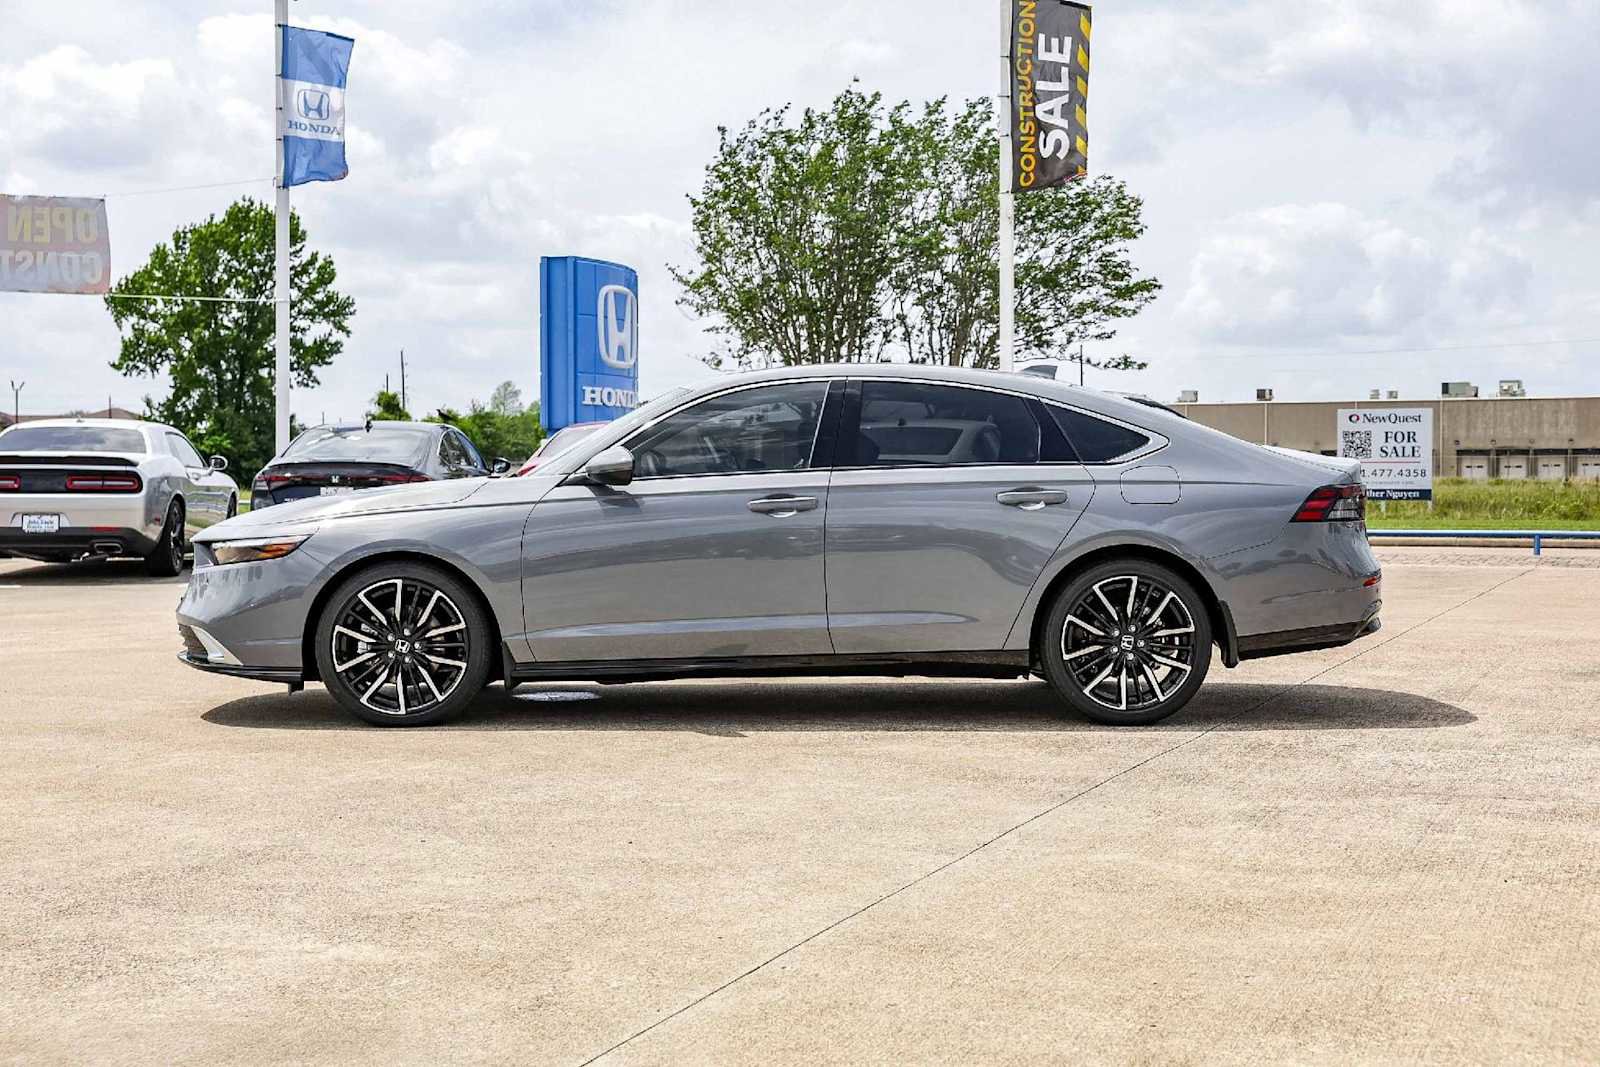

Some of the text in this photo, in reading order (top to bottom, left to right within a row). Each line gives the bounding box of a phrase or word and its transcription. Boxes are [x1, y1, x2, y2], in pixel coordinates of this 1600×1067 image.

[1016, 1, 1036, 187] CONSTRUCTION
[1035, 33, 1072, 160] SALE
[288, 120, 341, 135] HONDA
[582, 386, 638, 408] HOND
[1362, 413, 1422, 424] NewQuest
[1384, 431, 1417, 443] FOR
[1380, 446, 1421, 458] SALE
[1386, 489, 1420, 499] Nguyen
